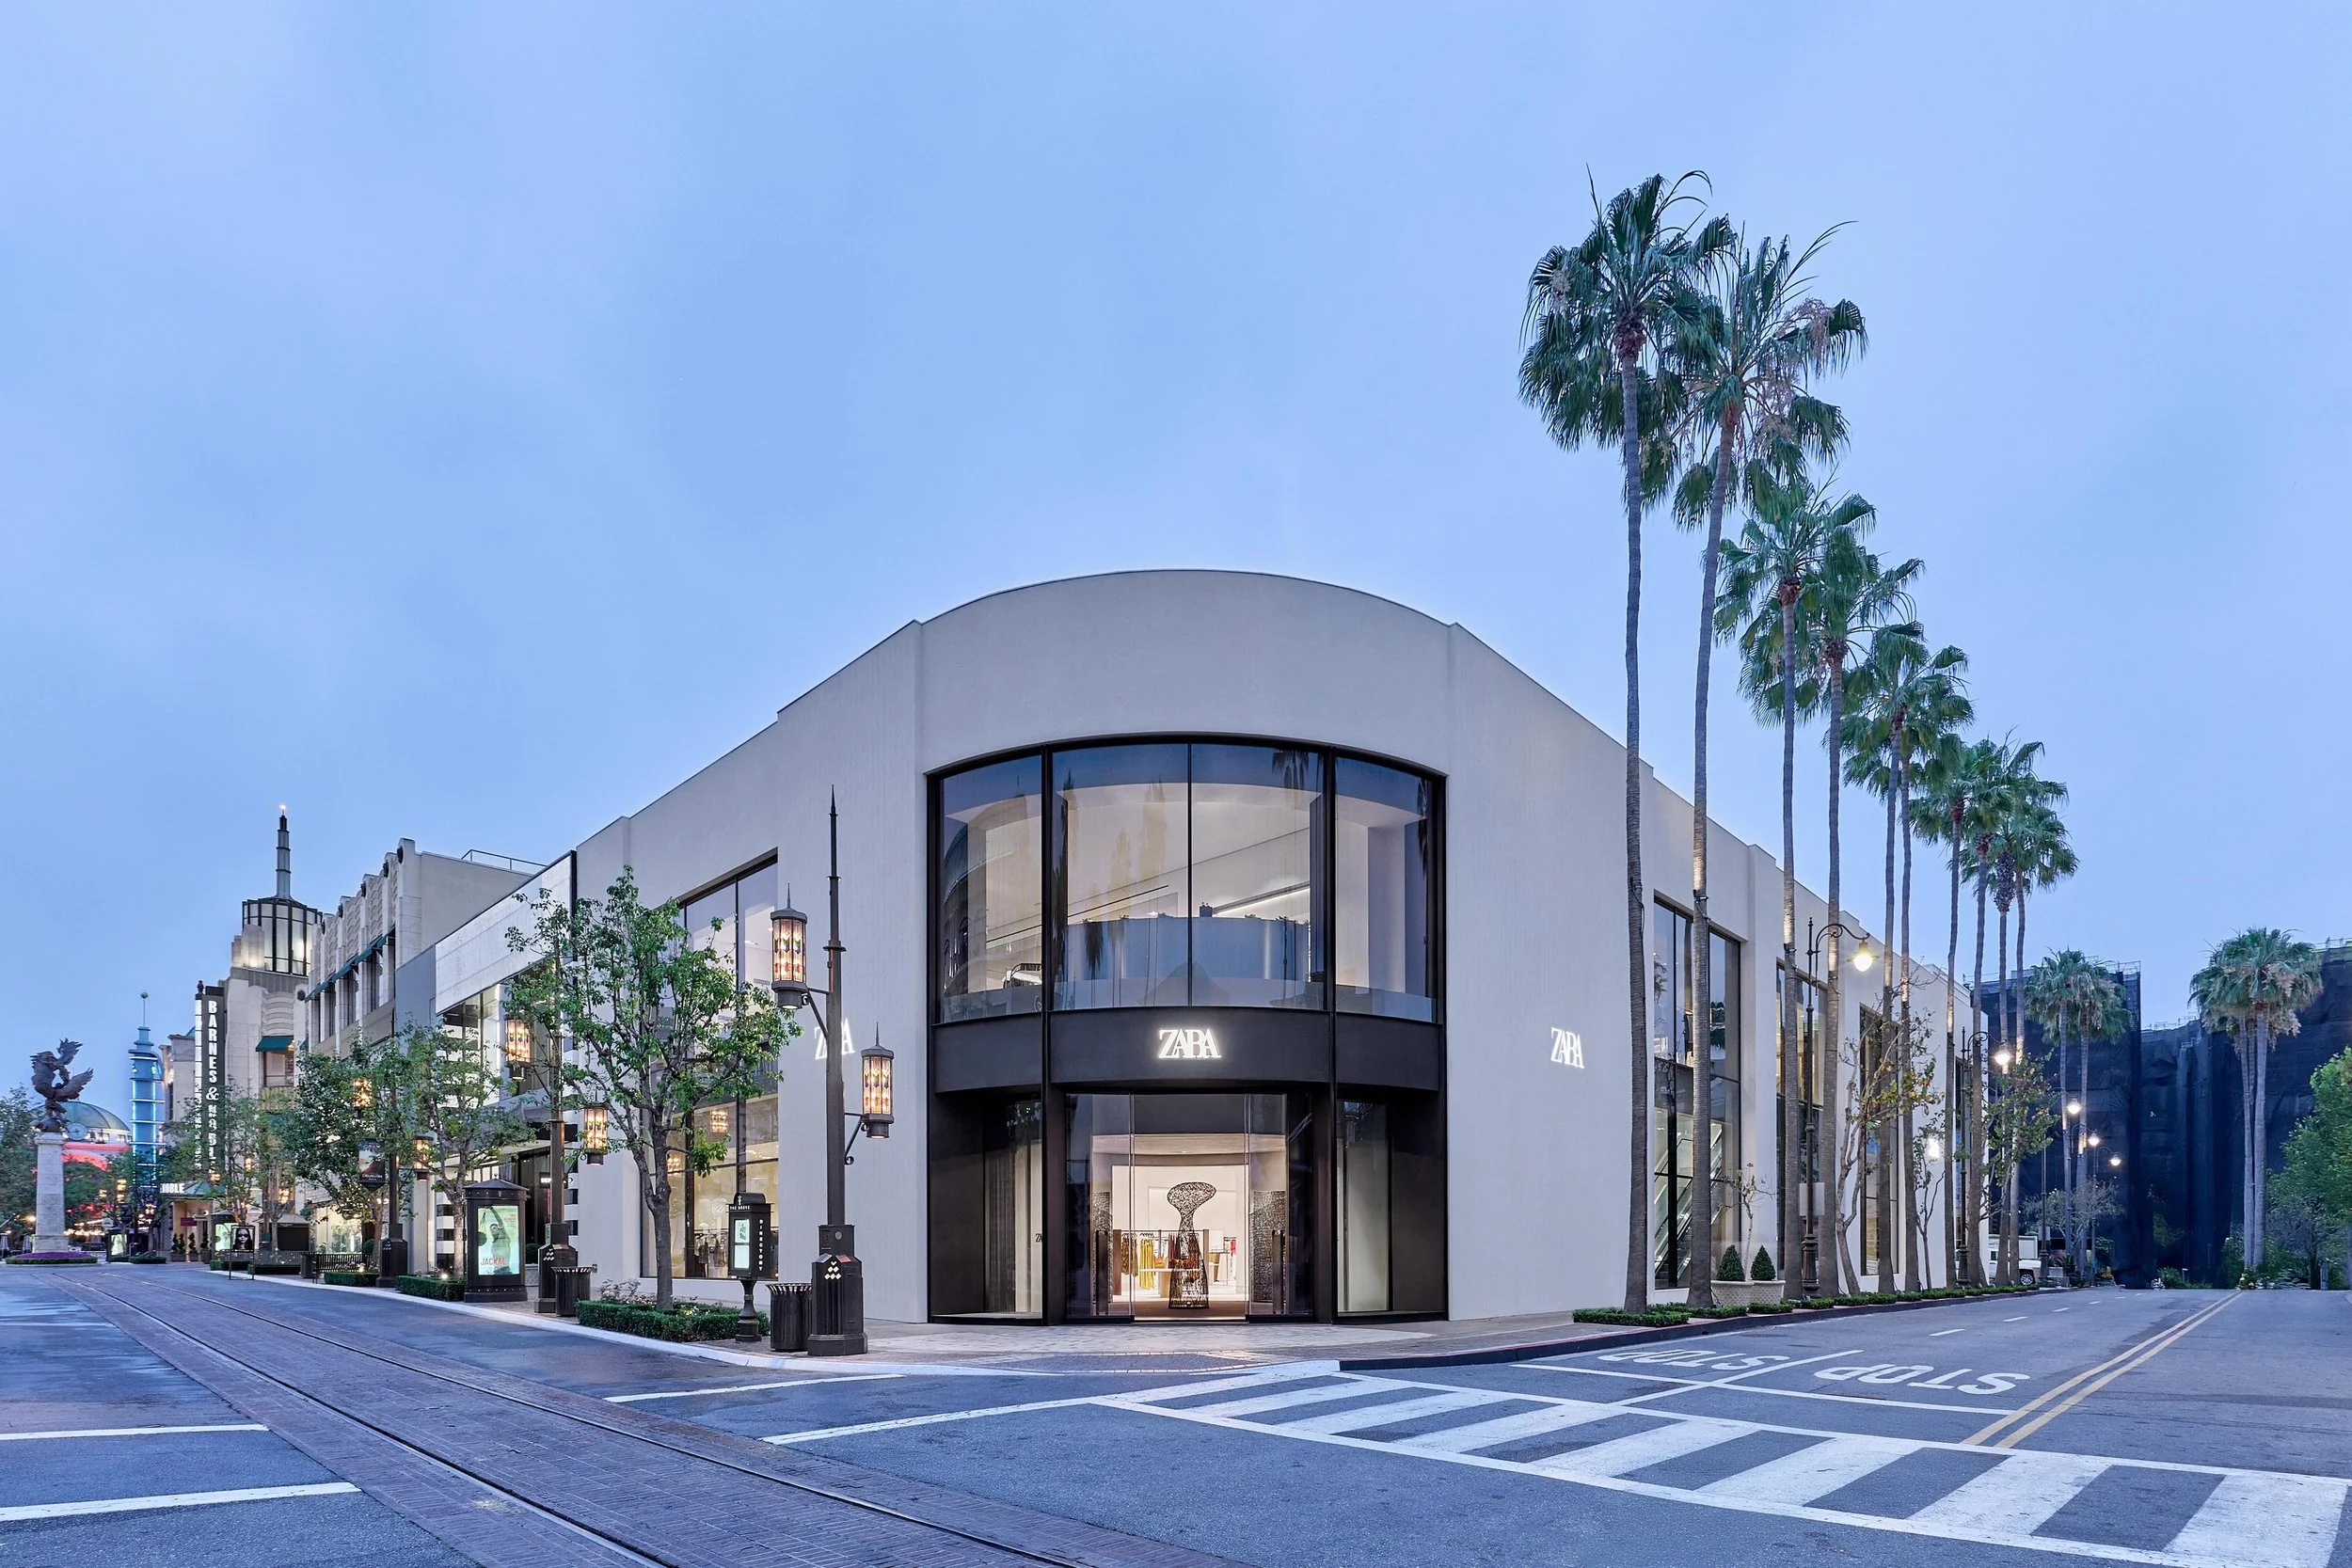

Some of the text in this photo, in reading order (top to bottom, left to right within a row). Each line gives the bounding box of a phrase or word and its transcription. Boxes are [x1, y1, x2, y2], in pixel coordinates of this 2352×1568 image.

[208, 1000, 217, 1083] BARNES
[814, 1017, 855, 1060] ZA
[1158, 1028, 1222, 1059] ZARA
[1550, 1026, 1585, 1069] ZARA
[206, 1086, 219, 1101] &
[1597, 1349, 1791, 1370] STOP
[1813, 1363, 2031, 1395] STOP
